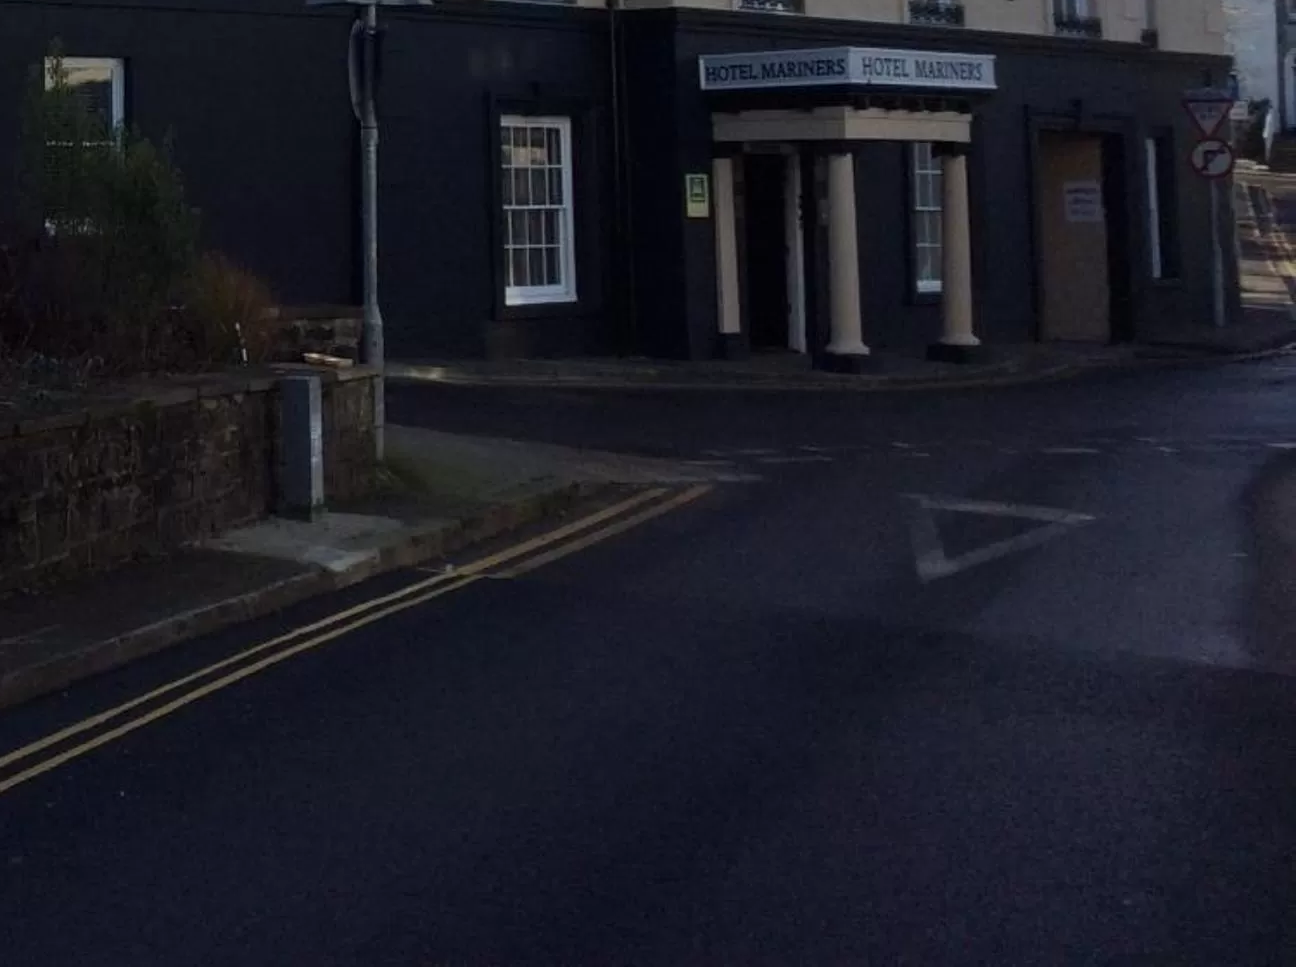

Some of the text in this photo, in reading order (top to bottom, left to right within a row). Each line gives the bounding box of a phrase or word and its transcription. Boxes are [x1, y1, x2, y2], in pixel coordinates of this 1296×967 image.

[705, 58, 846, 82] HOTEL MARINERS
[861, 57, 983, 81] HOTEL MARINERS
